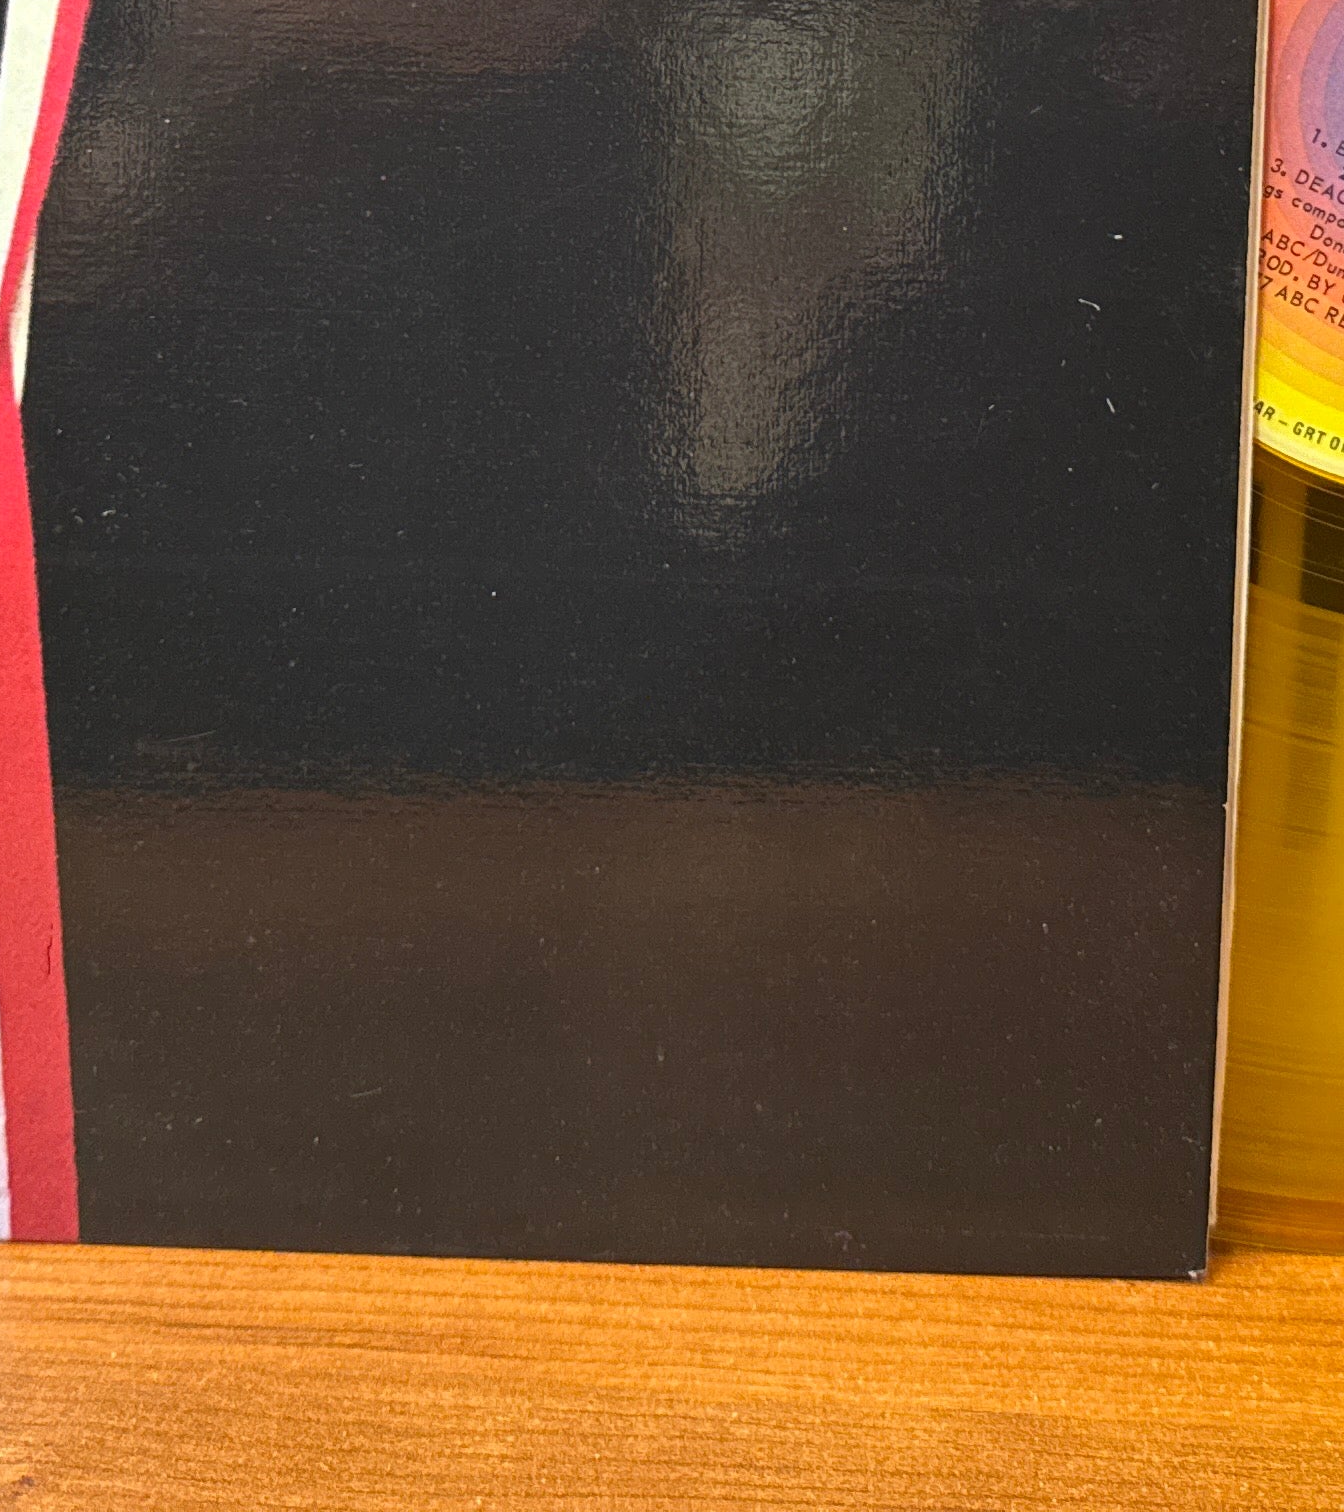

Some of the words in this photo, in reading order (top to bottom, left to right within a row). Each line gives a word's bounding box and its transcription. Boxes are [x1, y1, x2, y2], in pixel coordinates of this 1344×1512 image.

[1311, 129, 1327, 148] 1.
[1270, 158, 1287, 177] 3.
[1307, 274, 1336, 296] BY
[1274, 286, 1320, 315] ABC
[1292, 421, 1327, 445] GRT
